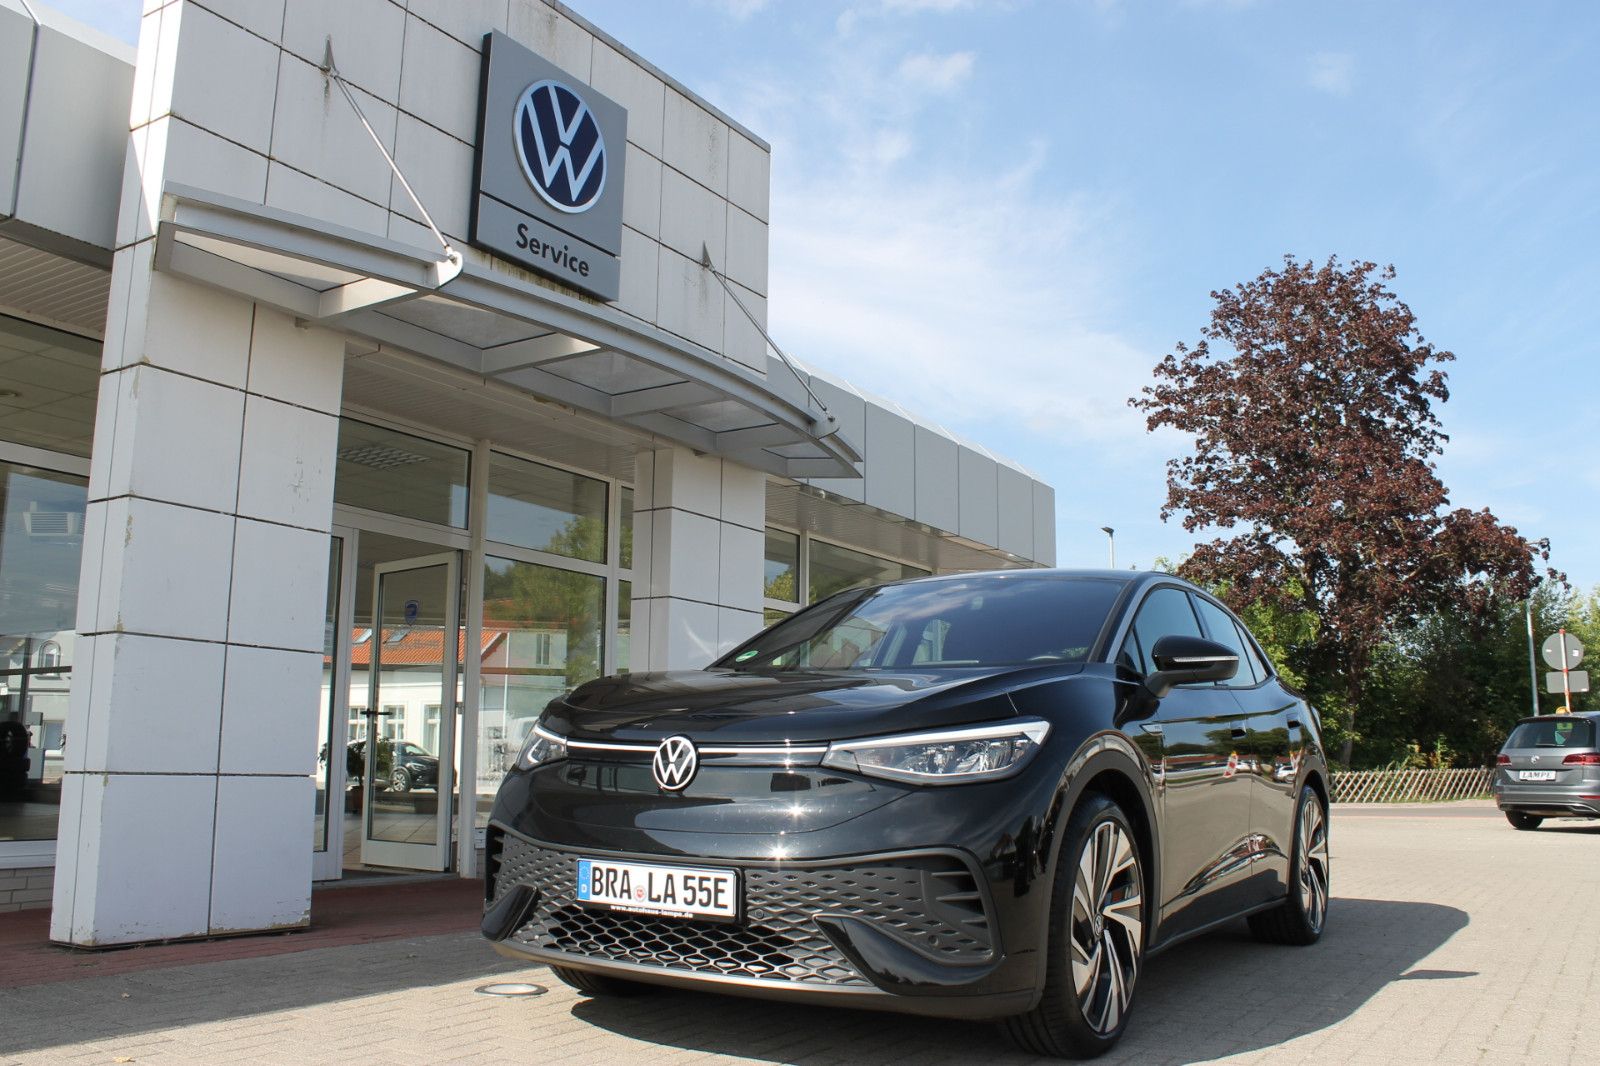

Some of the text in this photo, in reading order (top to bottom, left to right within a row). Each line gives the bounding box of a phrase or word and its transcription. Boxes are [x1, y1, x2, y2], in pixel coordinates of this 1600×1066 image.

[515, 222, 590, 278] Service
[591, 866, 728, 909] BRA LA 55E
